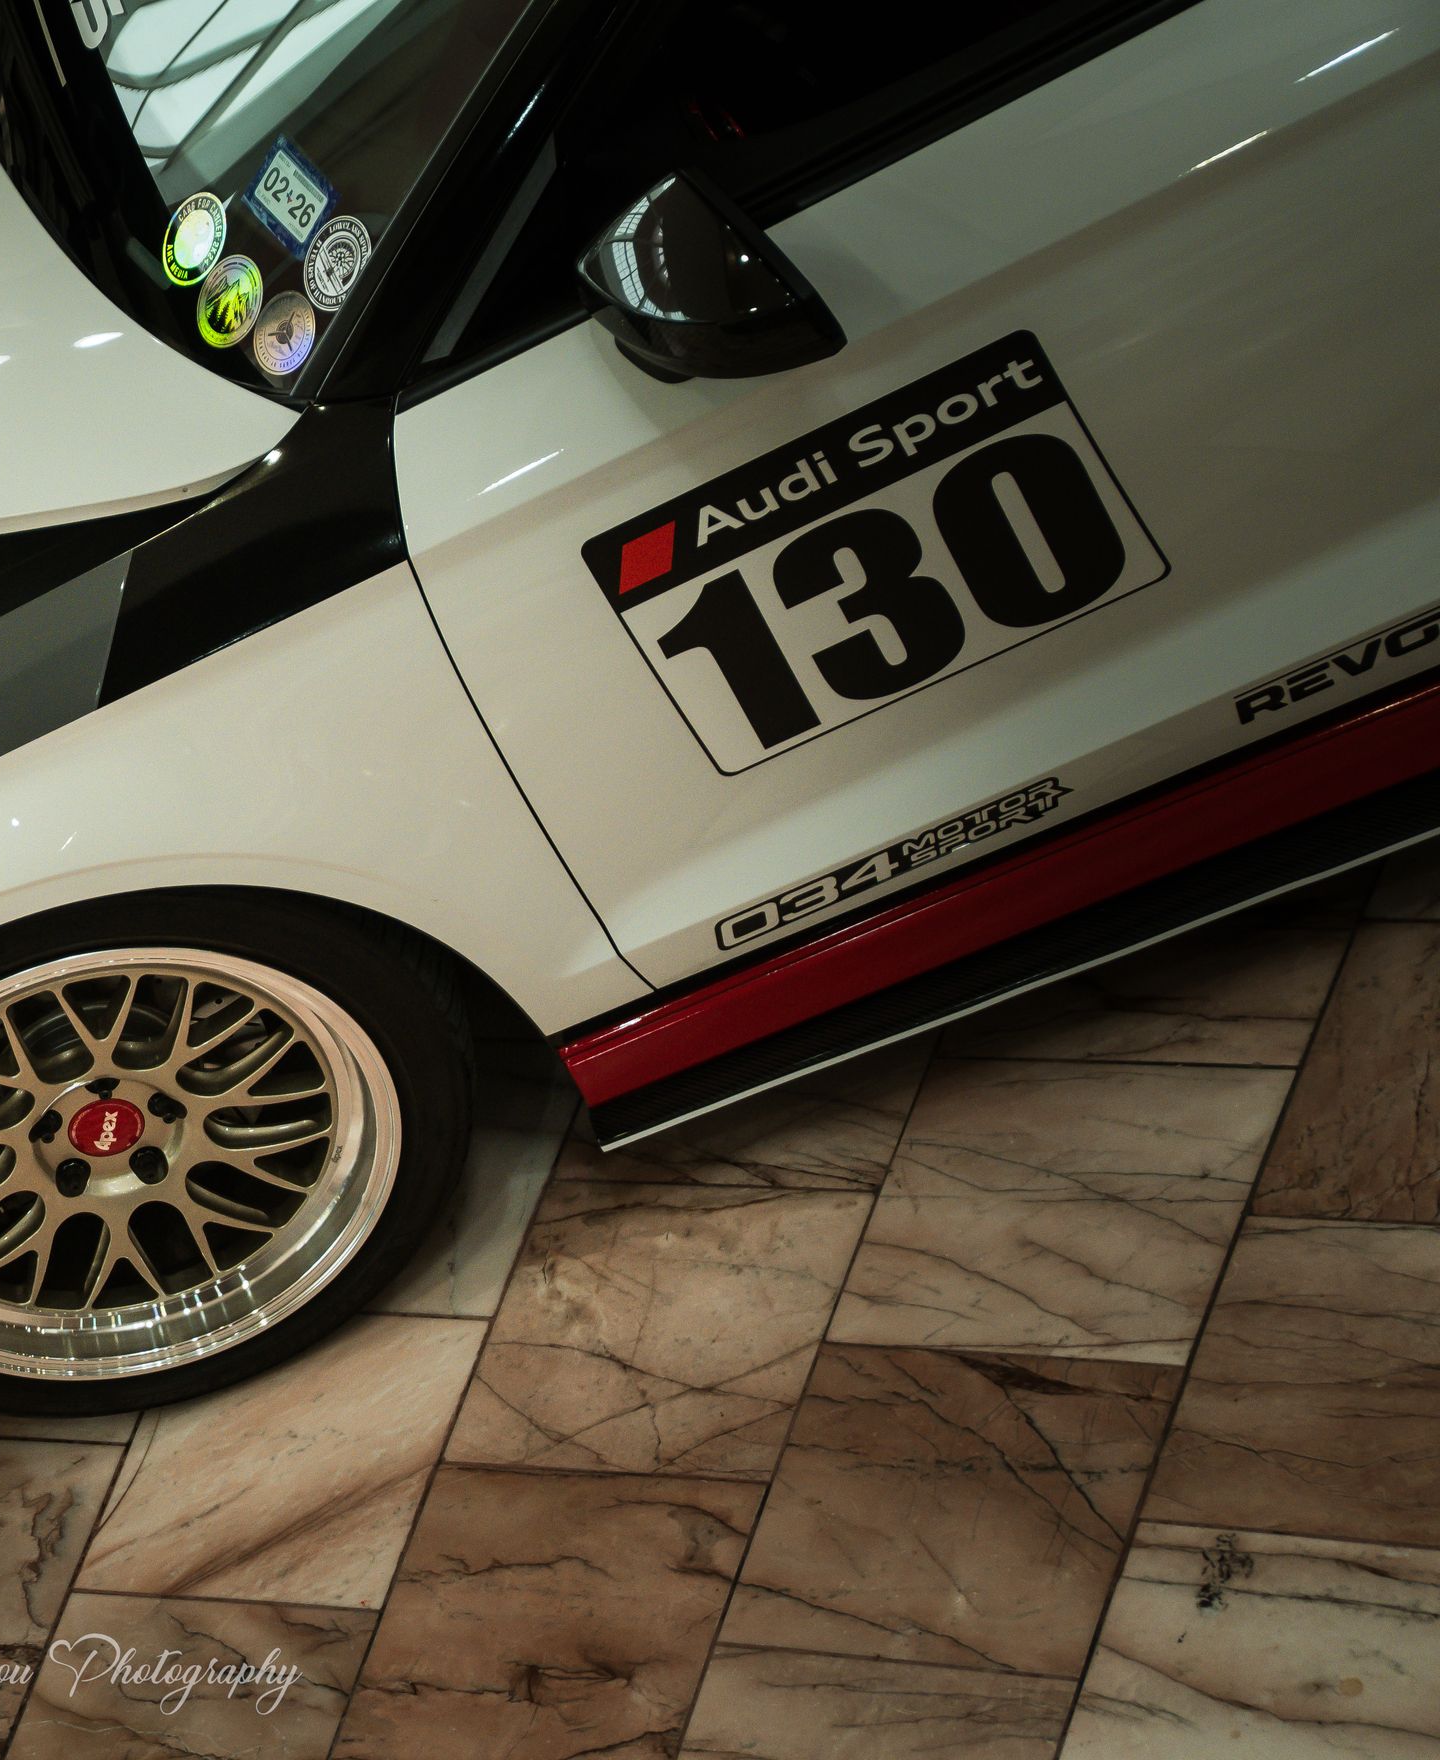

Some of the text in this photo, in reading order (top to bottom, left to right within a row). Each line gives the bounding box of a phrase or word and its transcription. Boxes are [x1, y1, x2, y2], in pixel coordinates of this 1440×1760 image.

[263, 166, 290, 203] 02
[287, 193, 316, 228] 26
[696, 359, 1044, 548] Audi Sport
[656, 433, 1127, 750] 130
[719, 779, 1066, 948] 034 MOTOR
[909, 794, 1062, 868] SPORT
[93, 1111, 119, 1151] Apex
